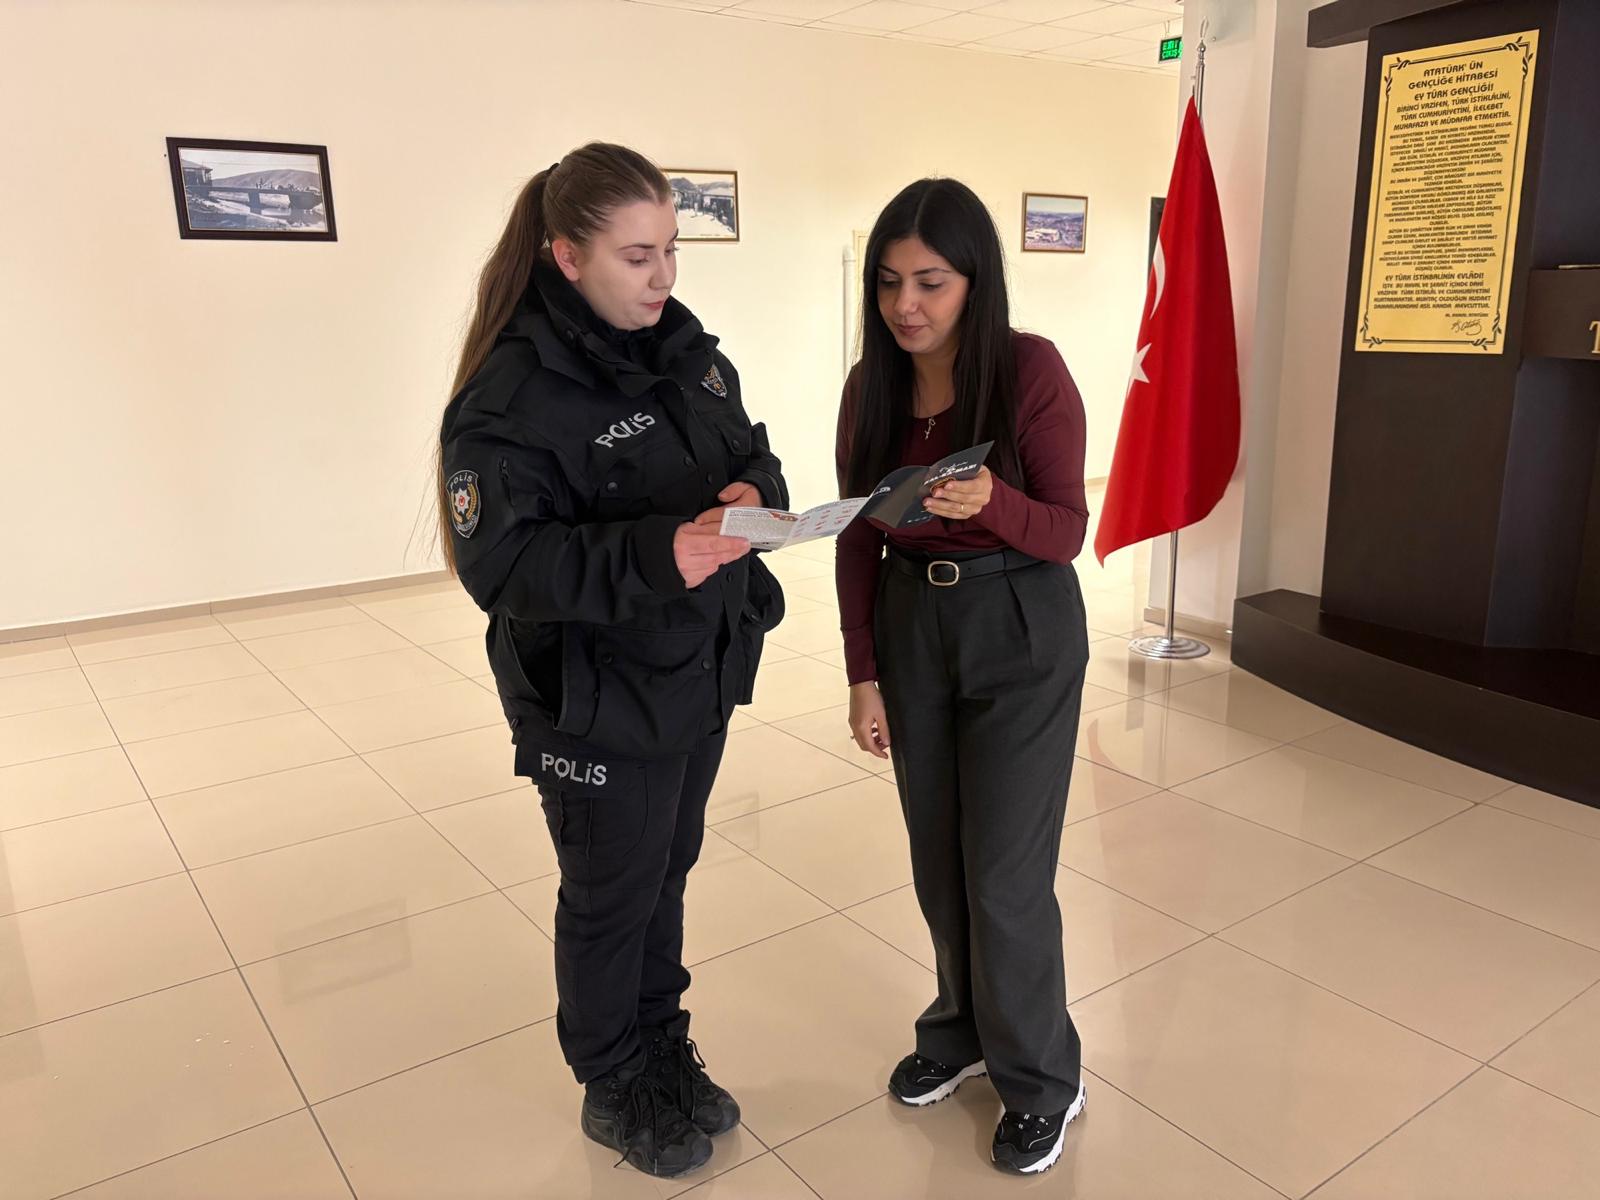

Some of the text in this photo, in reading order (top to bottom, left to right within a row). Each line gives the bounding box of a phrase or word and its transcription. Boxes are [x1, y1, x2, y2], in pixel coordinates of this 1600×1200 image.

[1408, 76, 1453, 89] GENÇLİĞE
[1414, 93, 1425, 101] EY
[1426, 89, 1448, 99] TÜRK
